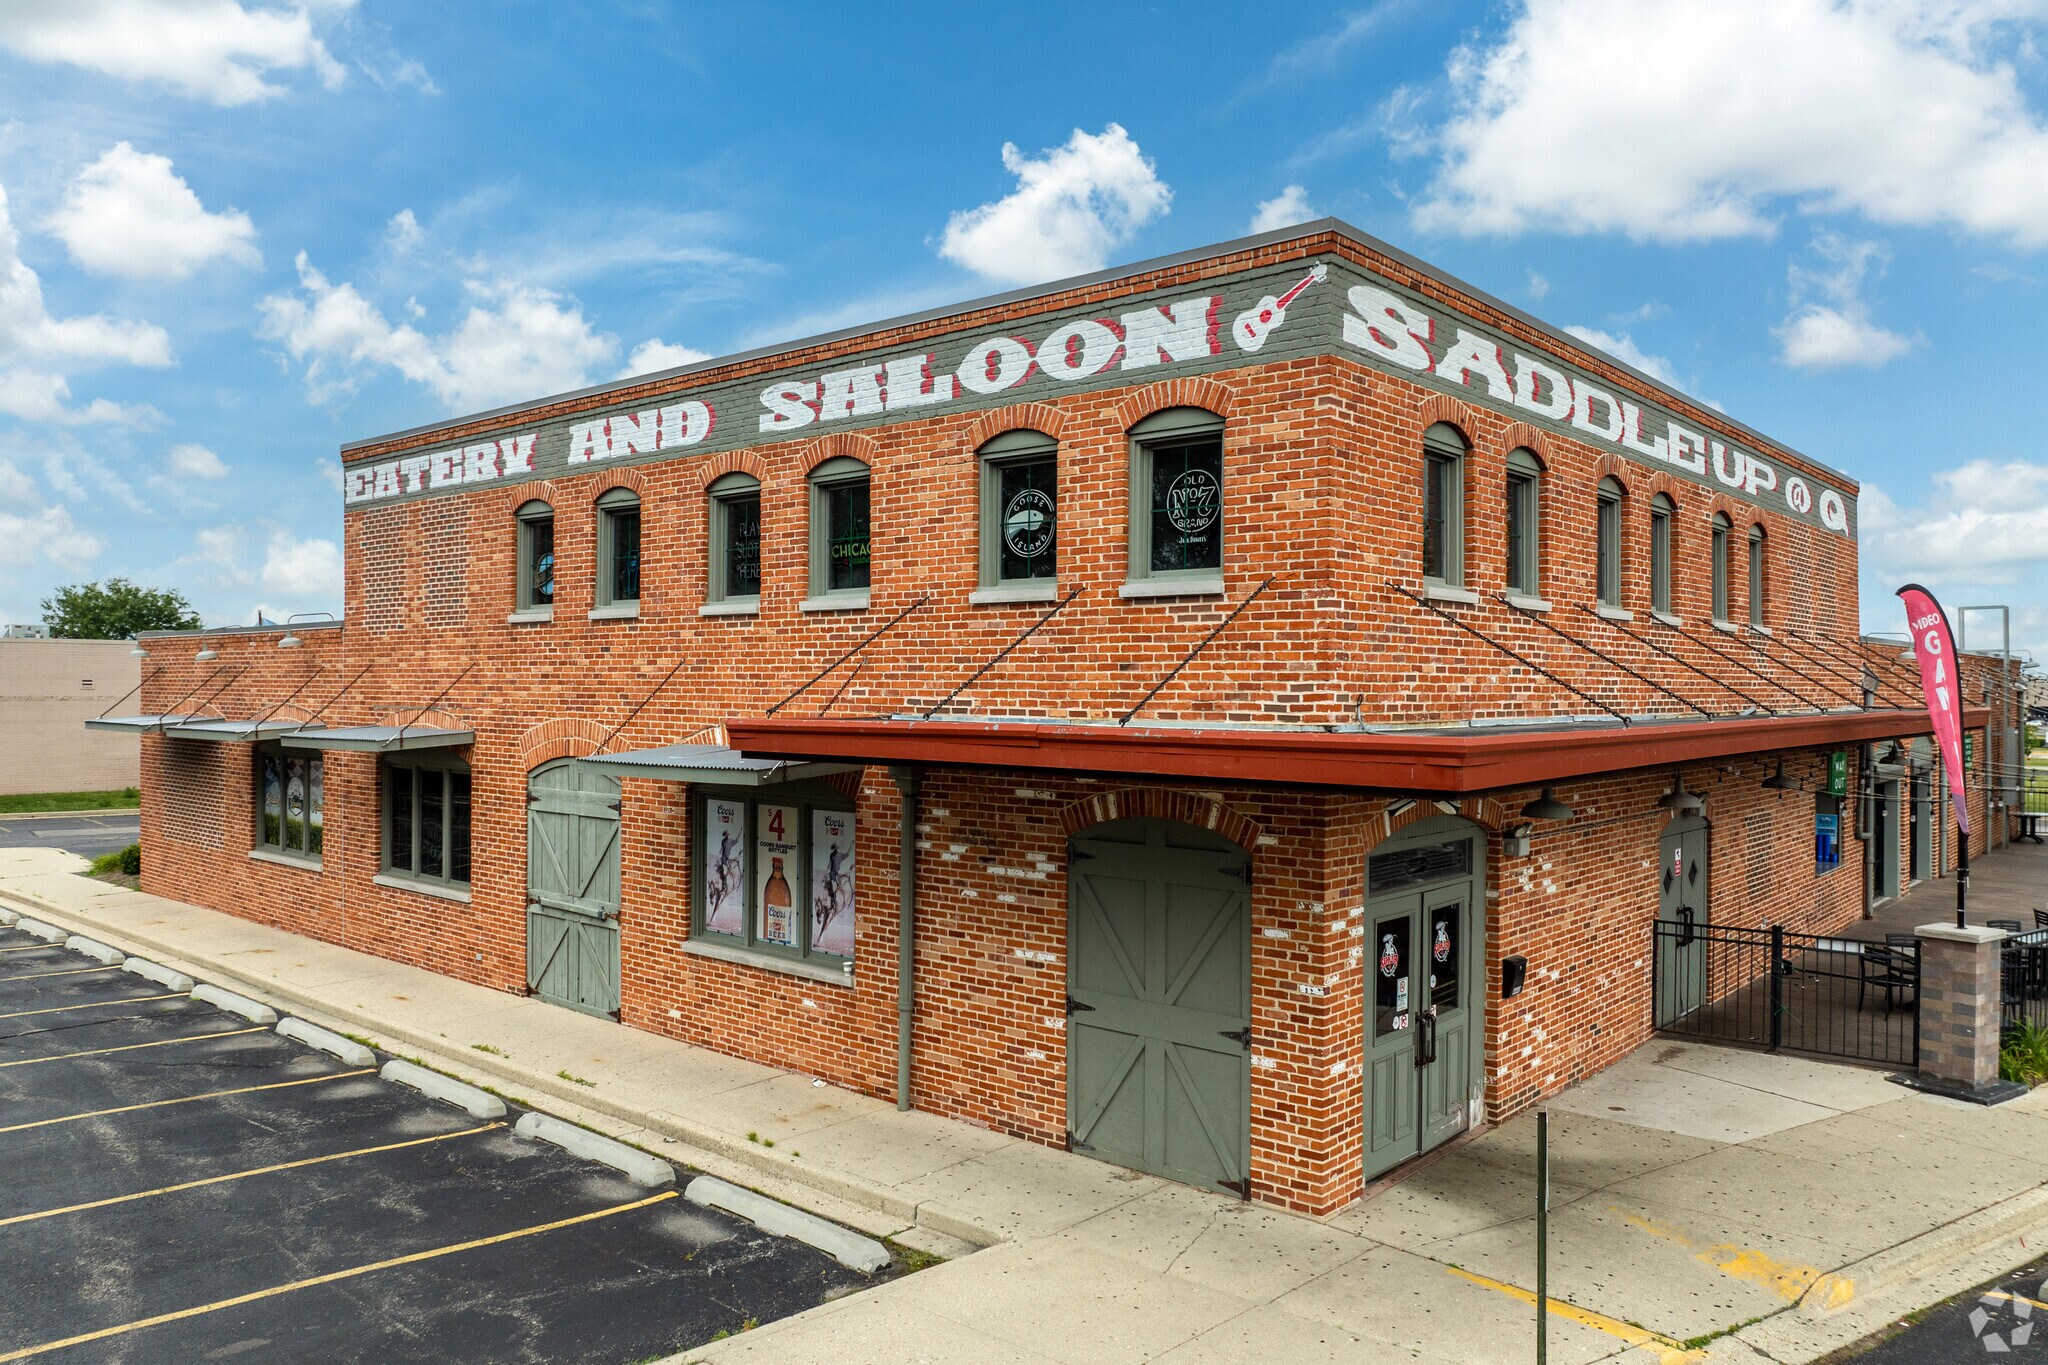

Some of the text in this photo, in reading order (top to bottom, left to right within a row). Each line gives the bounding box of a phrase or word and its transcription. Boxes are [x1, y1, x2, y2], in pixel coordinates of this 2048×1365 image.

[345, 295, 1223, 504] EATERY AND SALOON
[1184, 475, 1205, 485] OLD
[1013, 495, 1045, 512] GOOSE
[1198, 486, 1216, 516] 7
[1820, 489, 1849, 537] Q
[1177, 517, 1209, 528] GRAND
[737, 542, 760, 558] SLOT
[1014, 534, 1047, 551] ISLAND
[1912, 612, 1940, 631] VIDEO
[1834, 777, 1845, 790] OUT
[717, 804, 734, 816] Coors
[825, 815, 845, 828] Coors
[769, 905, 786, 919] Coors
[769, 930, 786, 940] BEER
